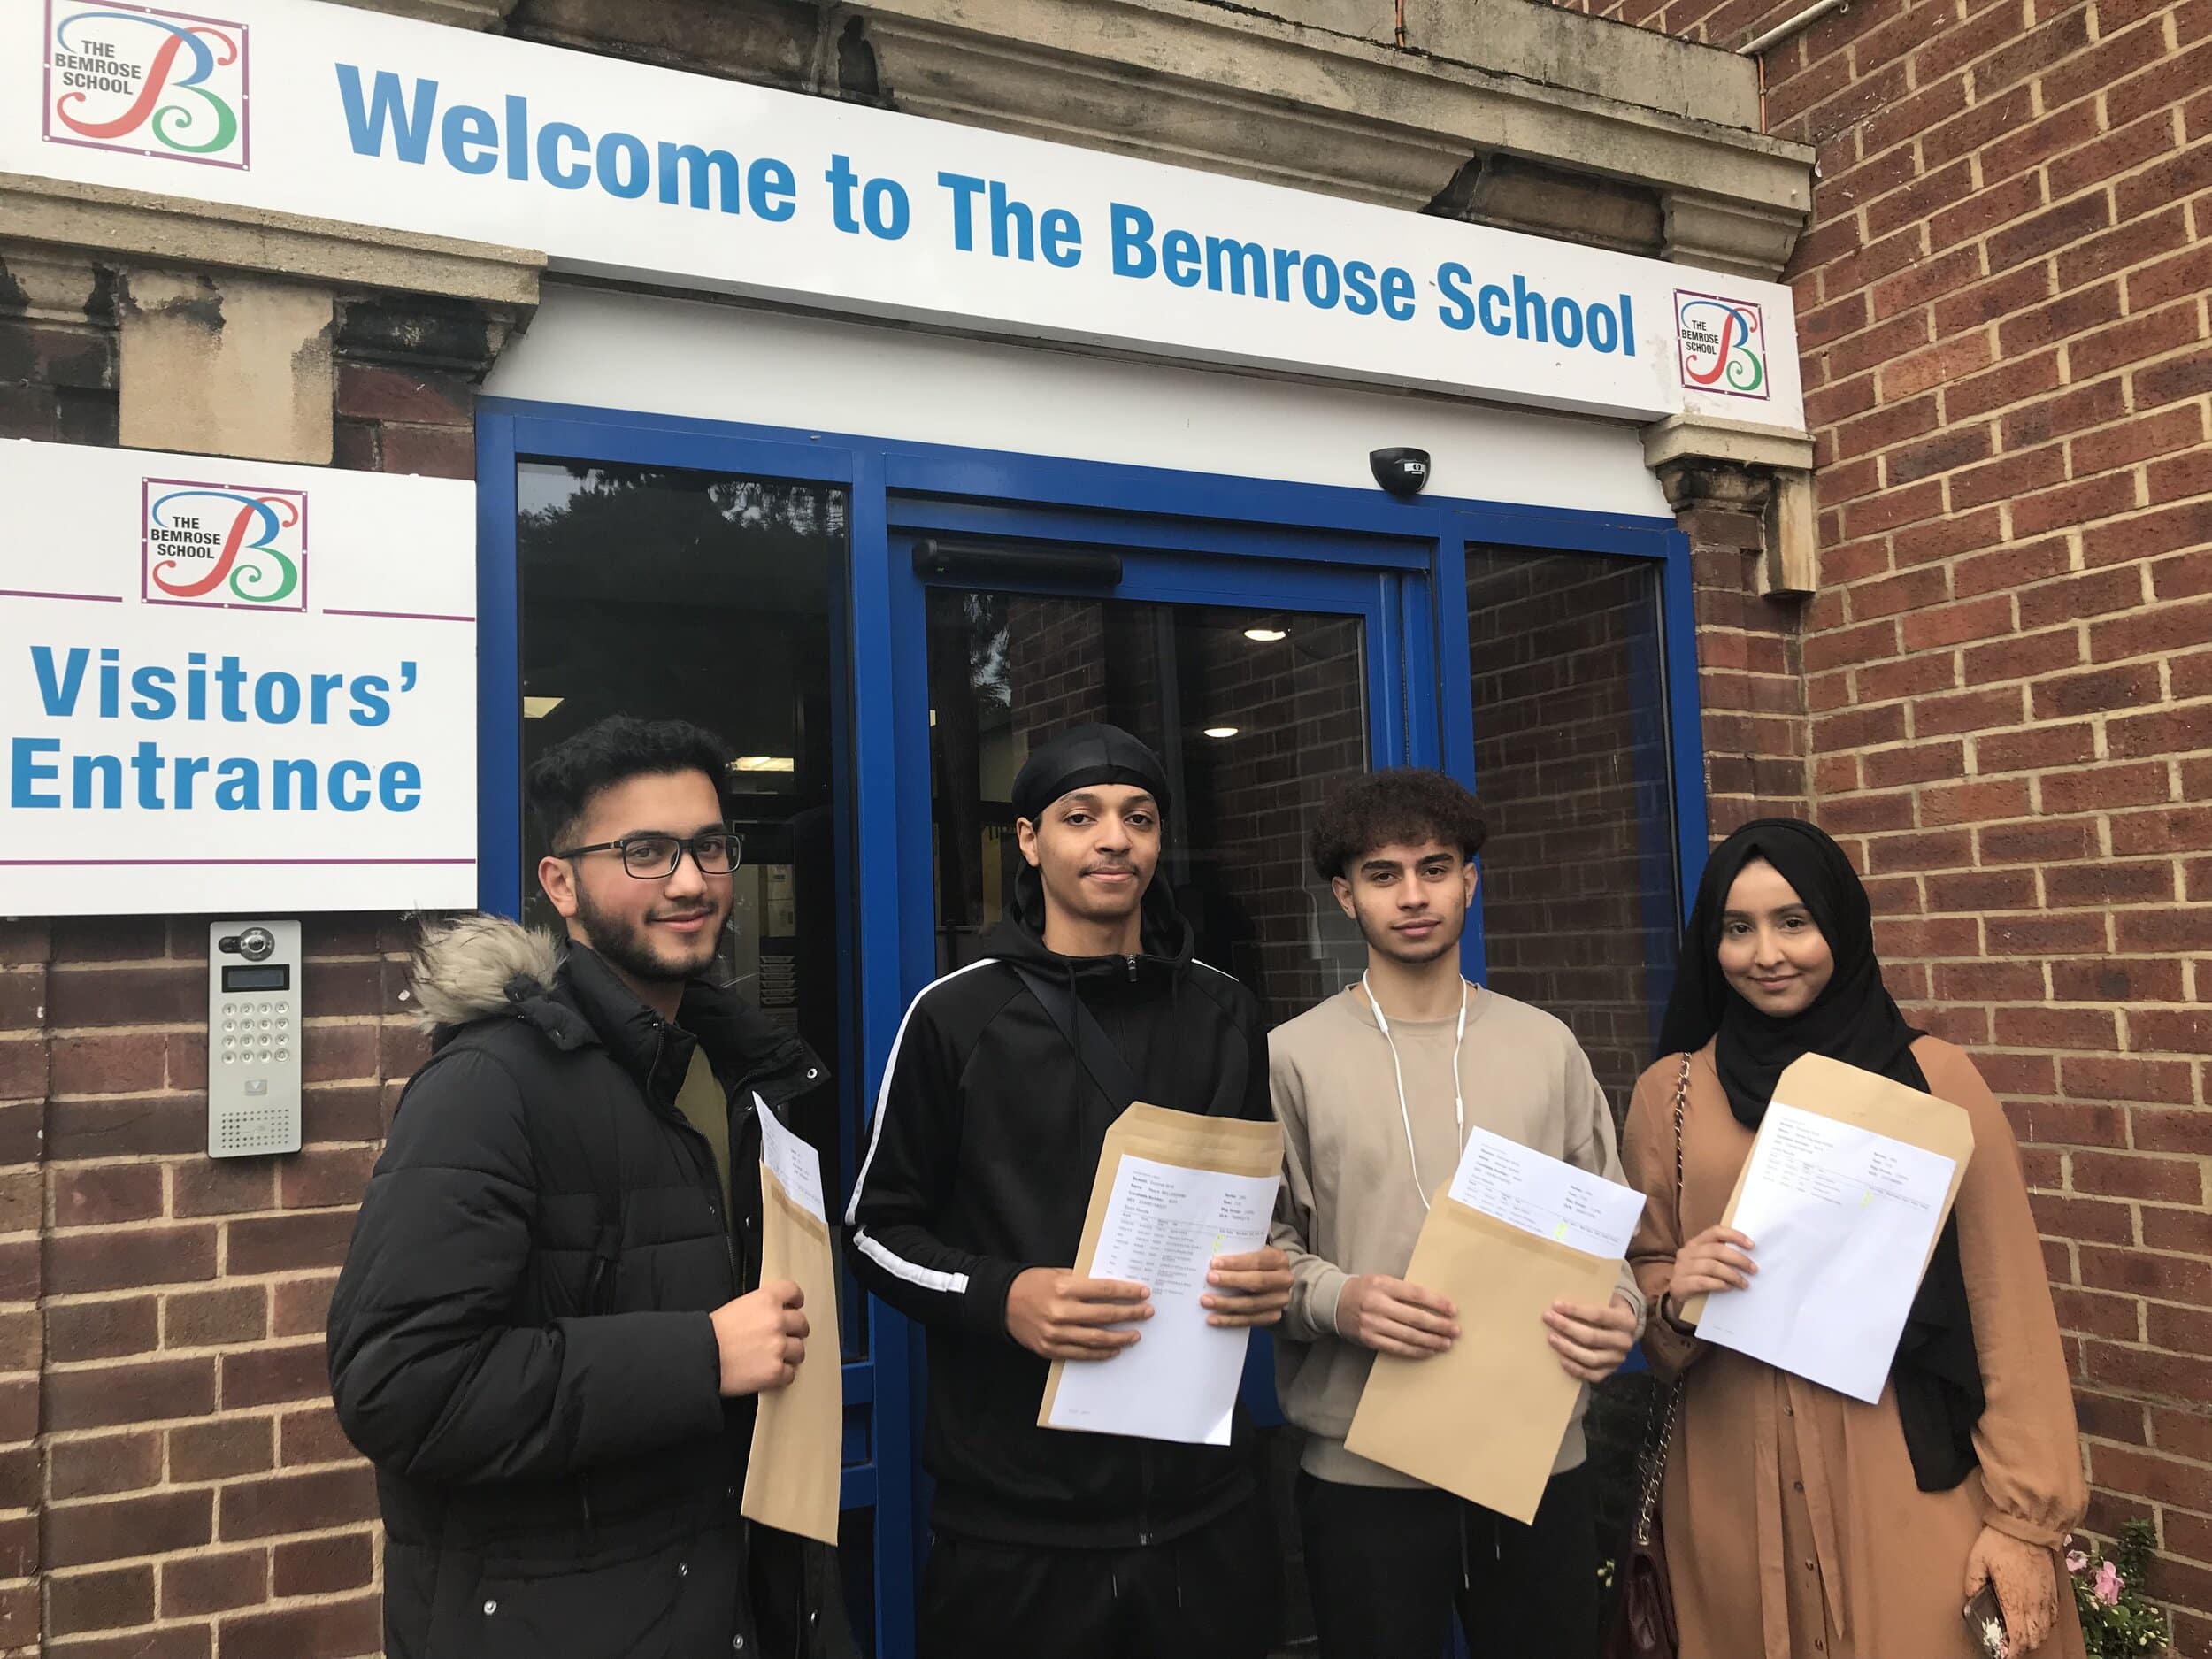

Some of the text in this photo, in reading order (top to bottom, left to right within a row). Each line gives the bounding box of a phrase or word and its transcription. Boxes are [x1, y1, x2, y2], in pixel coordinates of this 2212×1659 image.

[81, 40, 115, 58] THE
[55, 52, 142, 79] BEMROSE
[63, 71, 134, 95] SCHOOL
[337, 64, 1635, 357] Welcome to The Bemrose School
[1692, 319, 1707, 331] THE
[1681, 329, 1719, 344] BEMROSE
[1686, 342, 1717, 355] SCHOOL
[173, 517, 199, 529] THE
[151, 529, 221, 545] BEMROSE
[157, 543, 214, 558] SCHOOL
[30, 646, 418, 726] Visitors’
[11, 737, 421, 812] Entrance
